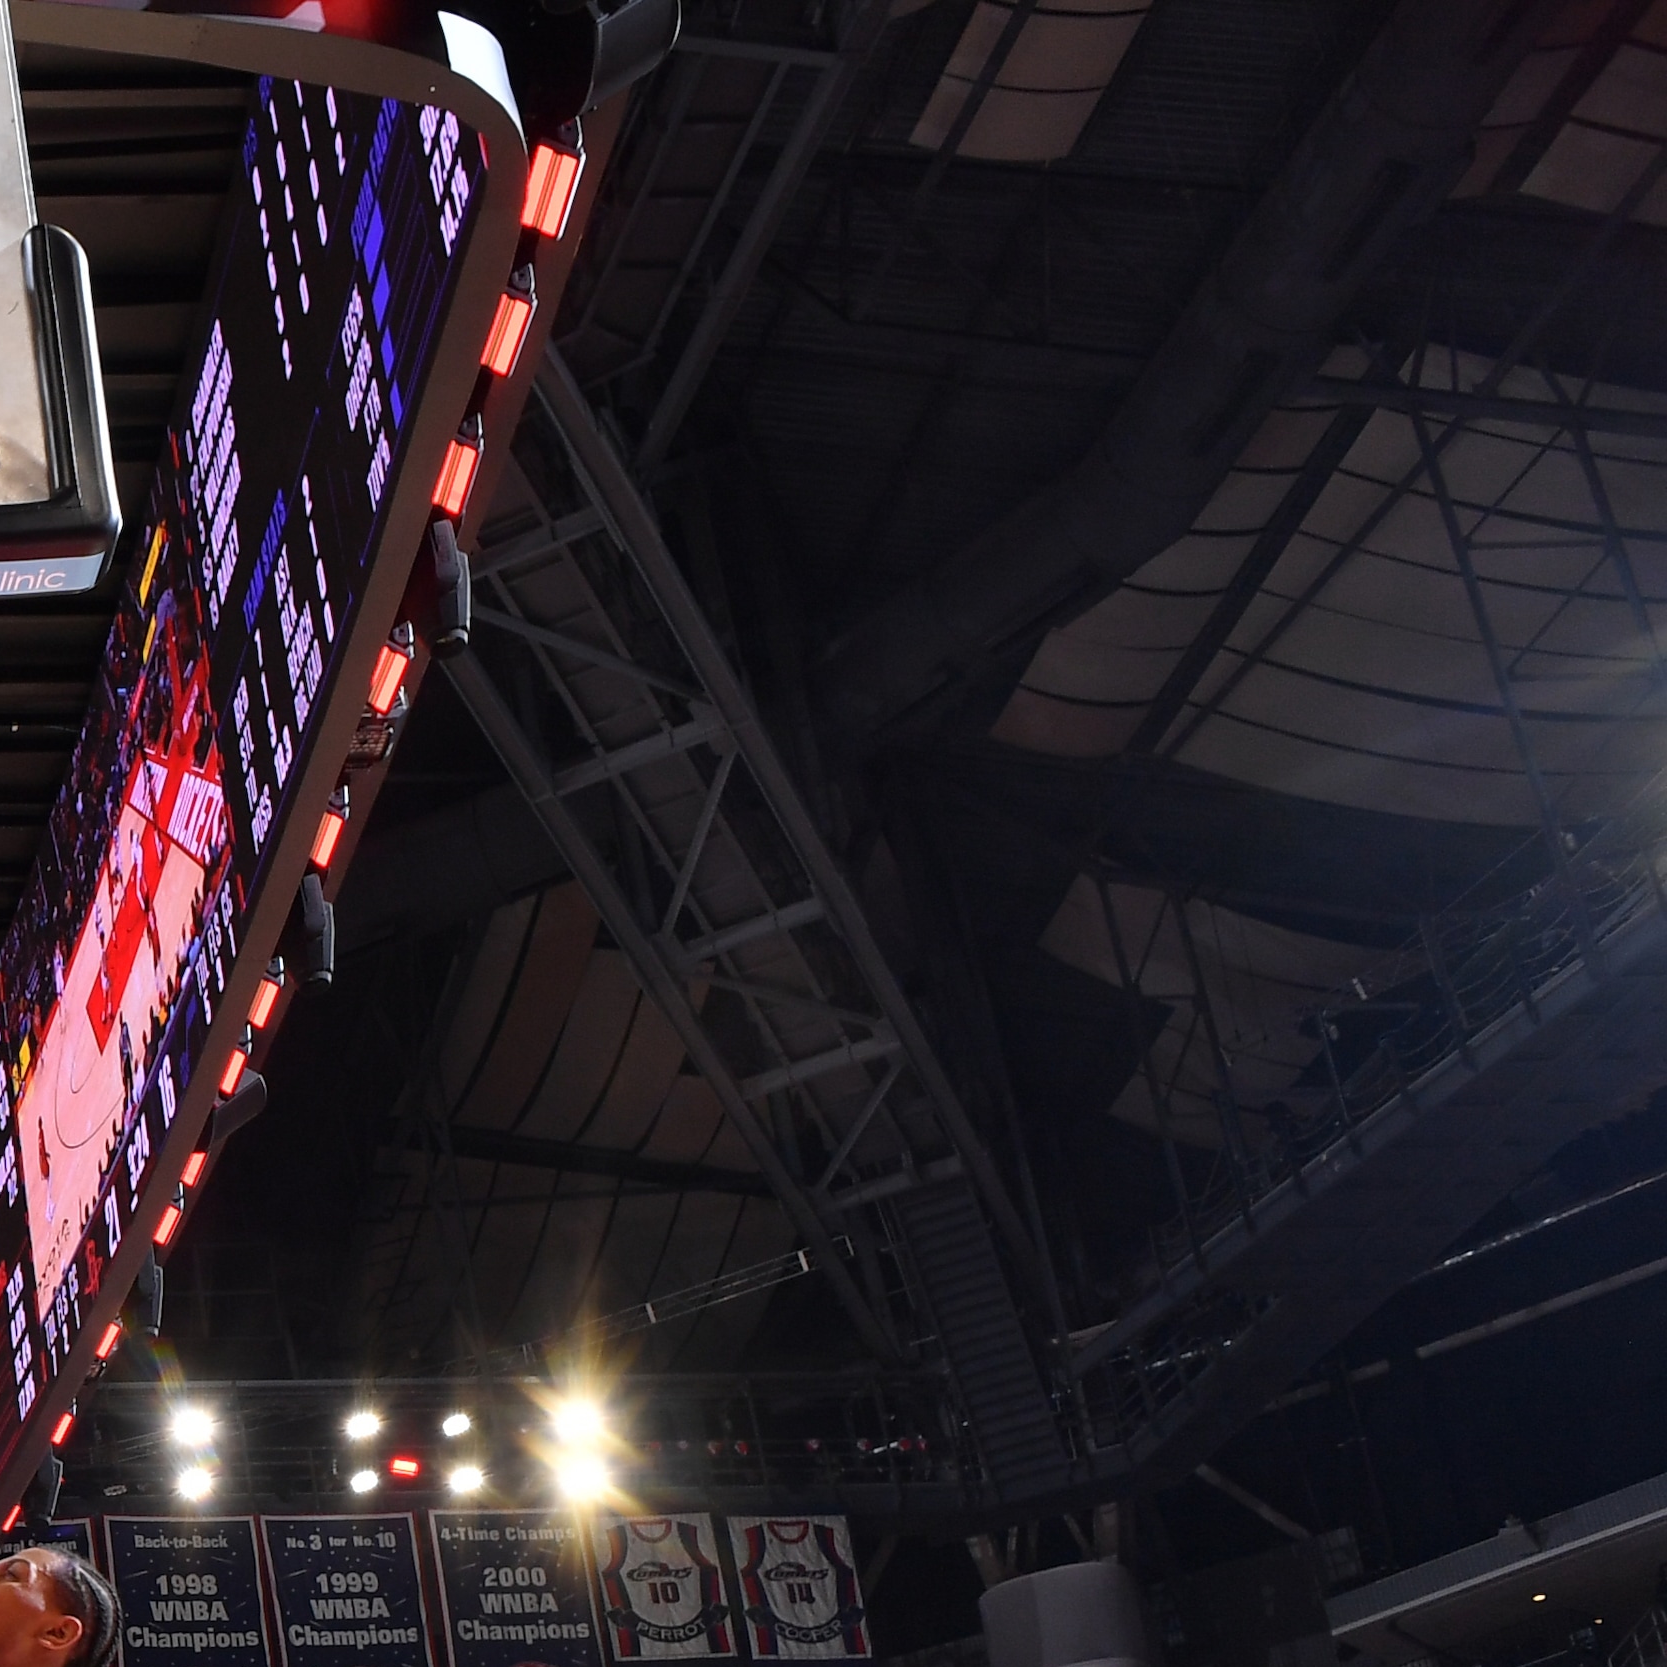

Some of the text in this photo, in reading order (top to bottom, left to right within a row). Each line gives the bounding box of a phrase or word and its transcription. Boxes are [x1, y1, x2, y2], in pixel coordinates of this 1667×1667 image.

[157, 1053, 176, 1130] 16
[127, 1112, 150, 1191] 3:24
[105, 1184, 122, 1259] 21
[133, 1533, 230, 1552] Back-to-Back
[310, 1532, 323, 1552] 3
[328, 1534, 347, 1549] for
[376, 1530, 397, 1550] 10
[439, 1523, 578, 1547] 4-Time Champs
[154, 1574, 219, 1598] 1998
[315, 1571, 381, 1595] 1999
[482, 1566, 548, 1590] 2000
[478, 1591, 559, 1615] WNBA
[648, 1580, 683, 1606] 10
[784, 1581, 818, 1606] 14
[150, 1599, 230, 1623] WNBA
[309, 1595, 391, 1620] WNBA
[126, 1625, 260, 1654] Champions
[288, 1622, 420, 1651] Champions
[457, 1616, 592, 1647] Champions
[634, 1620, 710, 1644] PERROT
[773, 1616, 845, 1643] COOPER
